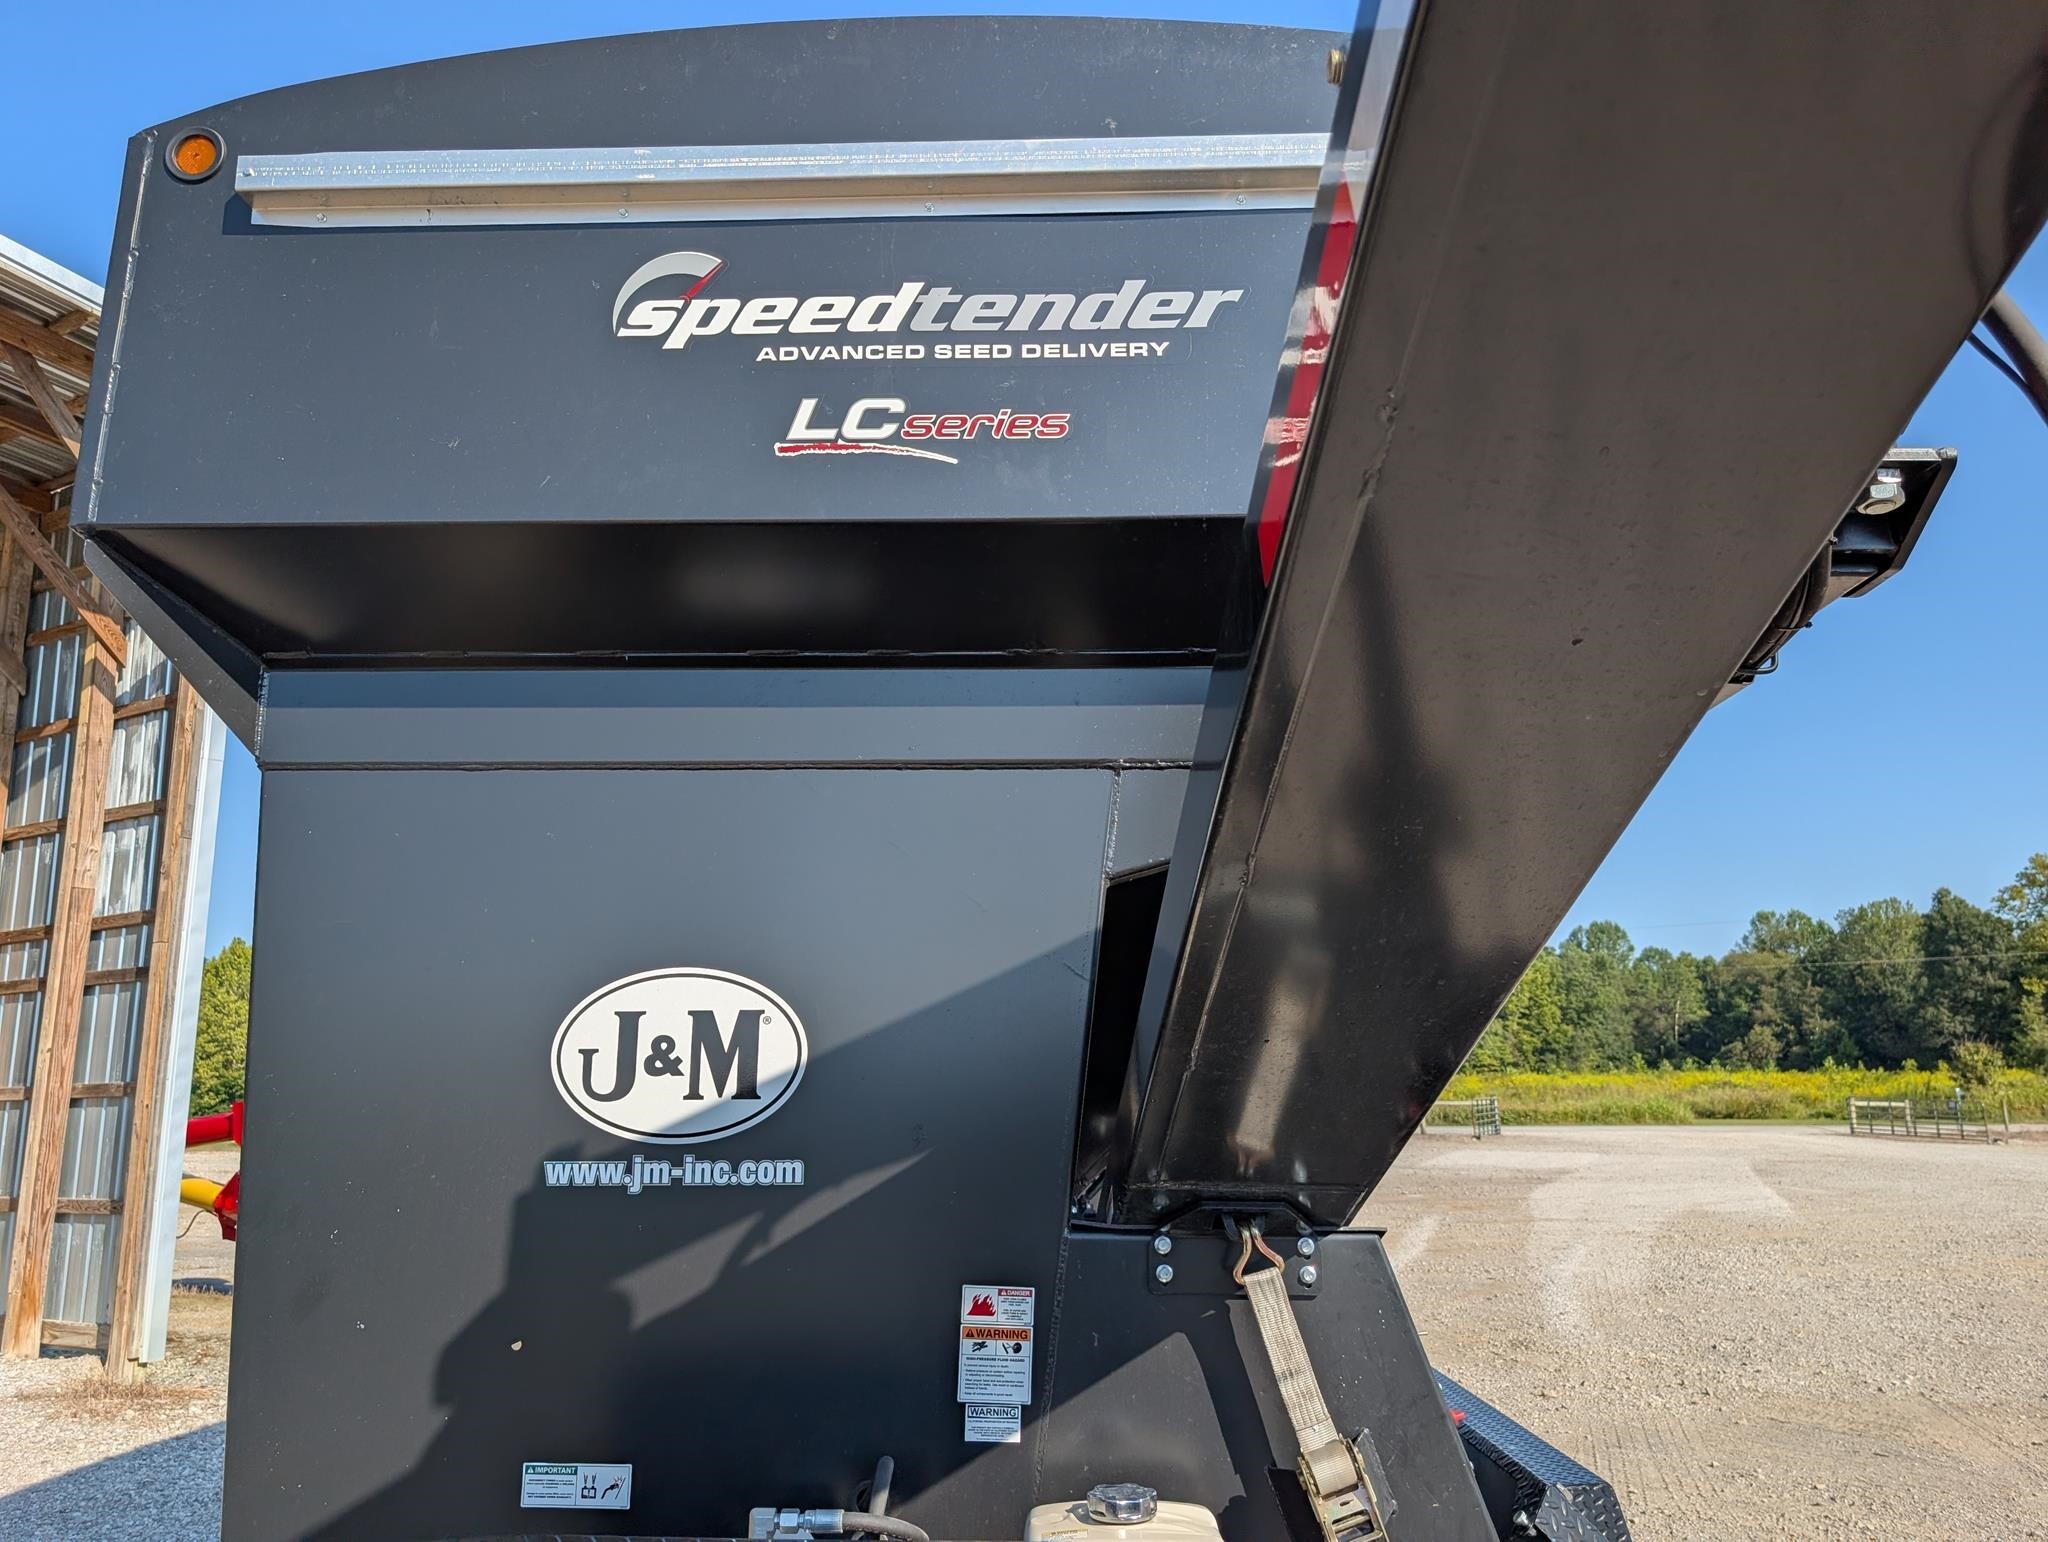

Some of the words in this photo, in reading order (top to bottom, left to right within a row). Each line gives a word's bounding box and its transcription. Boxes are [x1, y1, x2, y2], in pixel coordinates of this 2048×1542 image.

[756, 344, 925, 362] ADVANCED
[934, 343, 1013, 361] SEED
[1021, 341, 1171, 360] DELIVERY
[543, 1155, 805, 1195] www.jm-inc.com
[1007, 1289, 1031, 1297] DANGER
[975, 1328, 1029, 1340] WARNING
[970, 1407, 1017, 1418] WARNING
[535, 1466, 576, 1474] IMPORTANT
